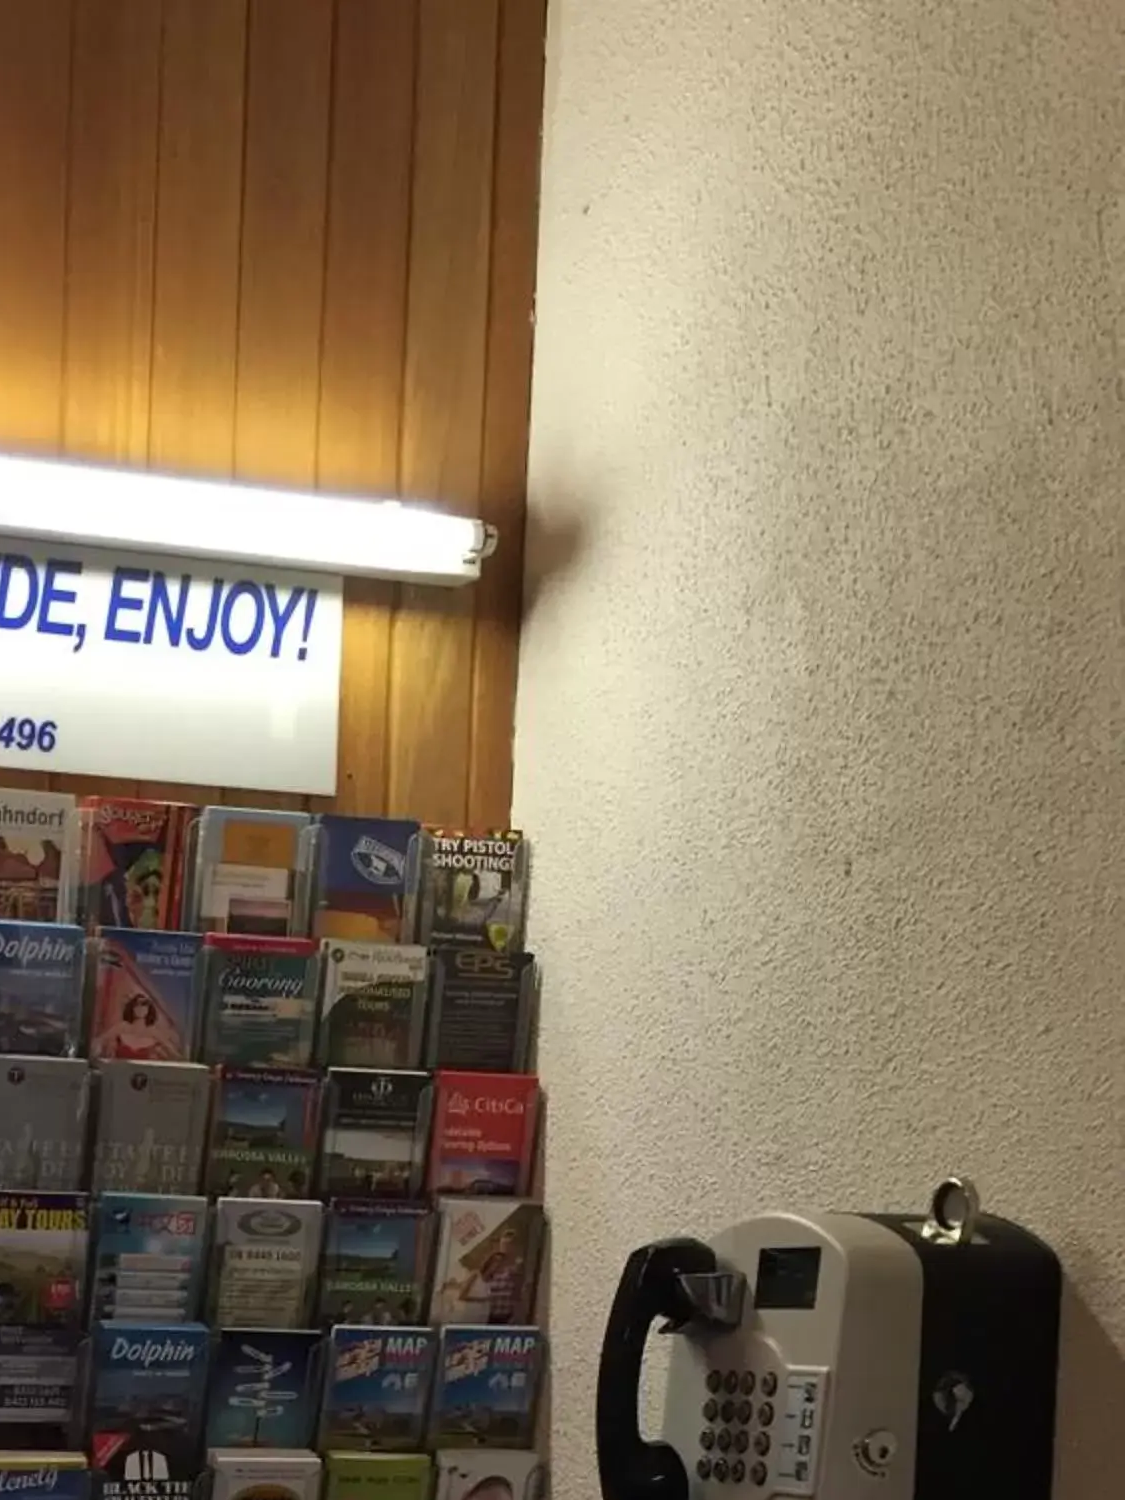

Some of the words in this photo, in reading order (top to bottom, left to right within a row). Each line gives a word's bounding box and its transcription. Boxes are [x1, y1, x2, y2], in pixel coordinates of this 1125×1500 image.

[103, 567, 318, 663] ENJOY!
[433, 837, 459, 852] TRY
[463, 838, 515, 856] PISTOL
[25, 1208, 86, 1232] TOURS
[110, 1337, 195, 1367] Dolphin
[385, 1336, 428, 1354] MAP
[493, 1336, 536, 1354] MAP
[103, 1481, 159, 1495] BLACK
